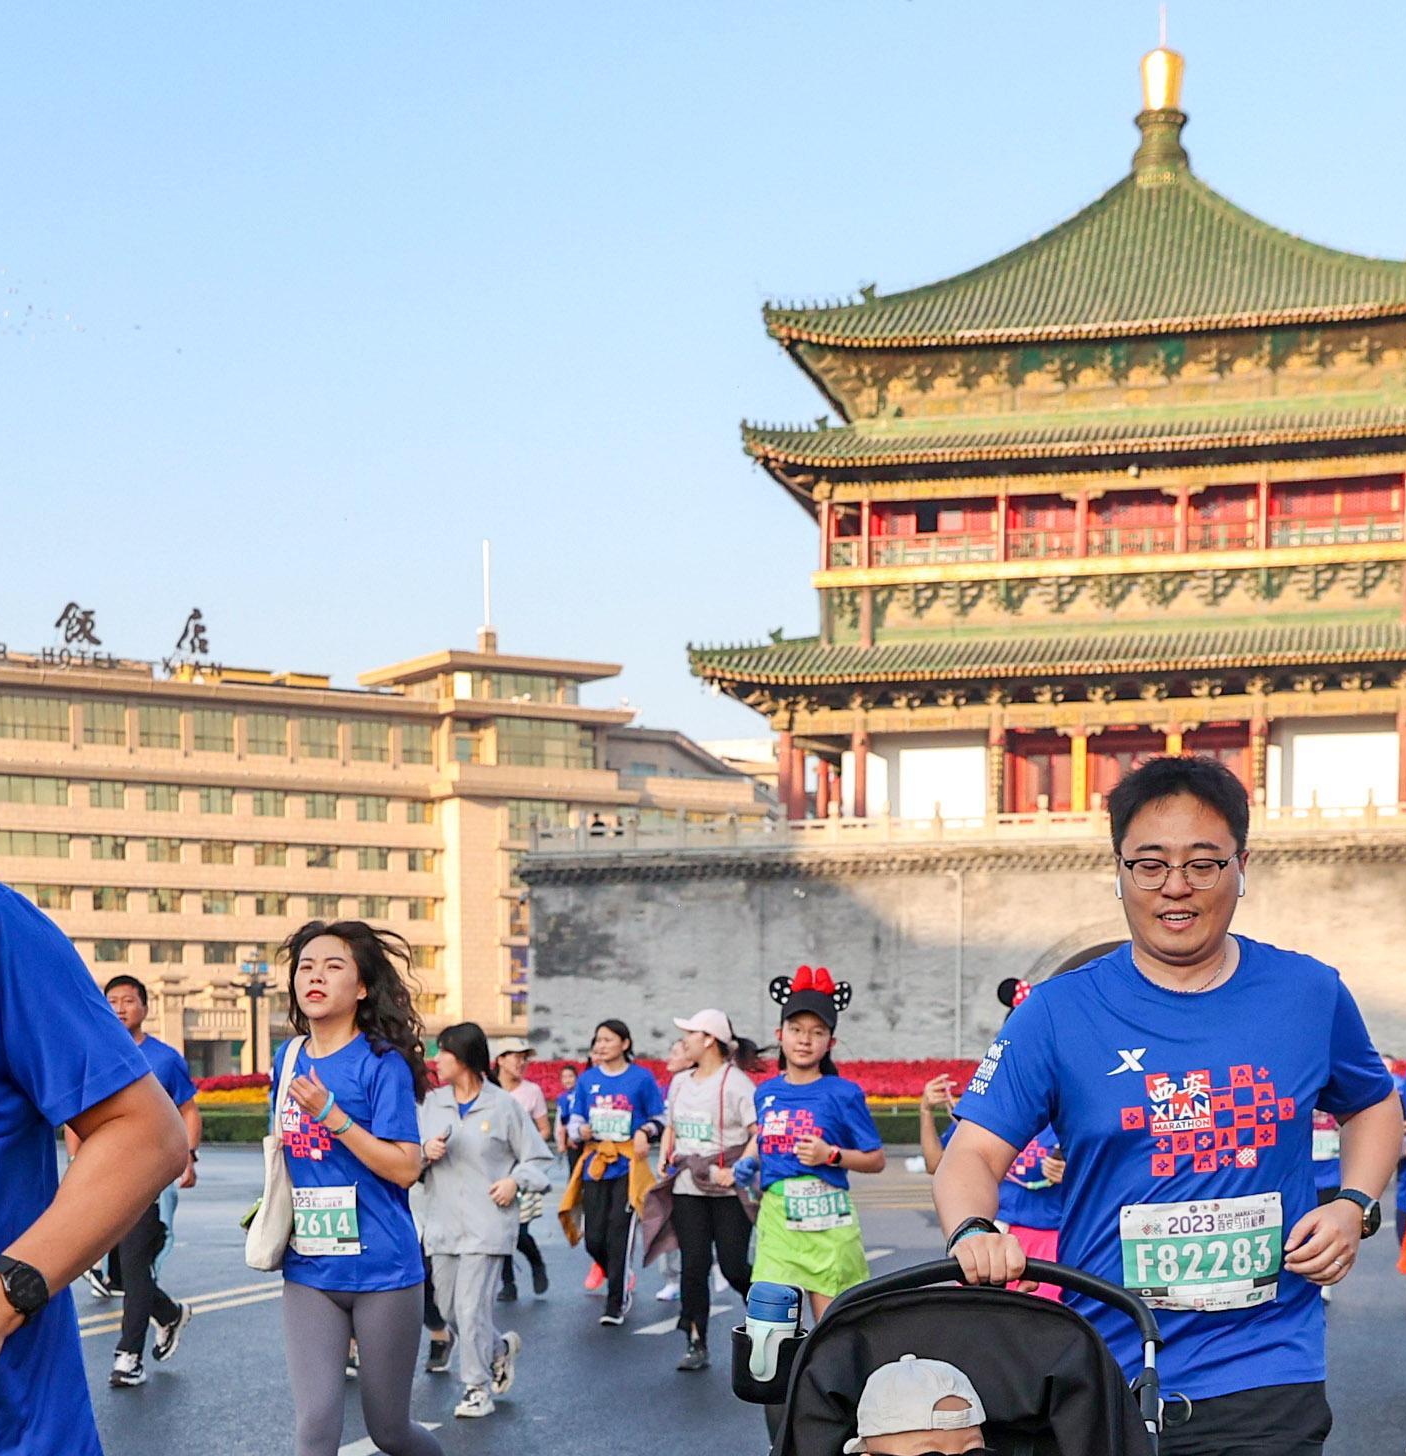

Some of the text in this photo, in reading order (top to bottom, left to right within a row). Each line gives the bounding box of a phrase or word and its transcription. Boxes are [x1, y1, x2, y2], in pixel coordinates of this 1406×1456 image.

[42, 648, 117, 670] HOTEL
[1148, 1072, 1211, 1102] 西安
[1150, 1099, 1212, 1122] XI'AN
[1153, 1119, 1211, 1132] MARATHON
[788, 1192, 846, 1218] F85814
[1167, 1214, 1215, 1236] 2023
[1135, 1233, 1273, 1283] F82283
